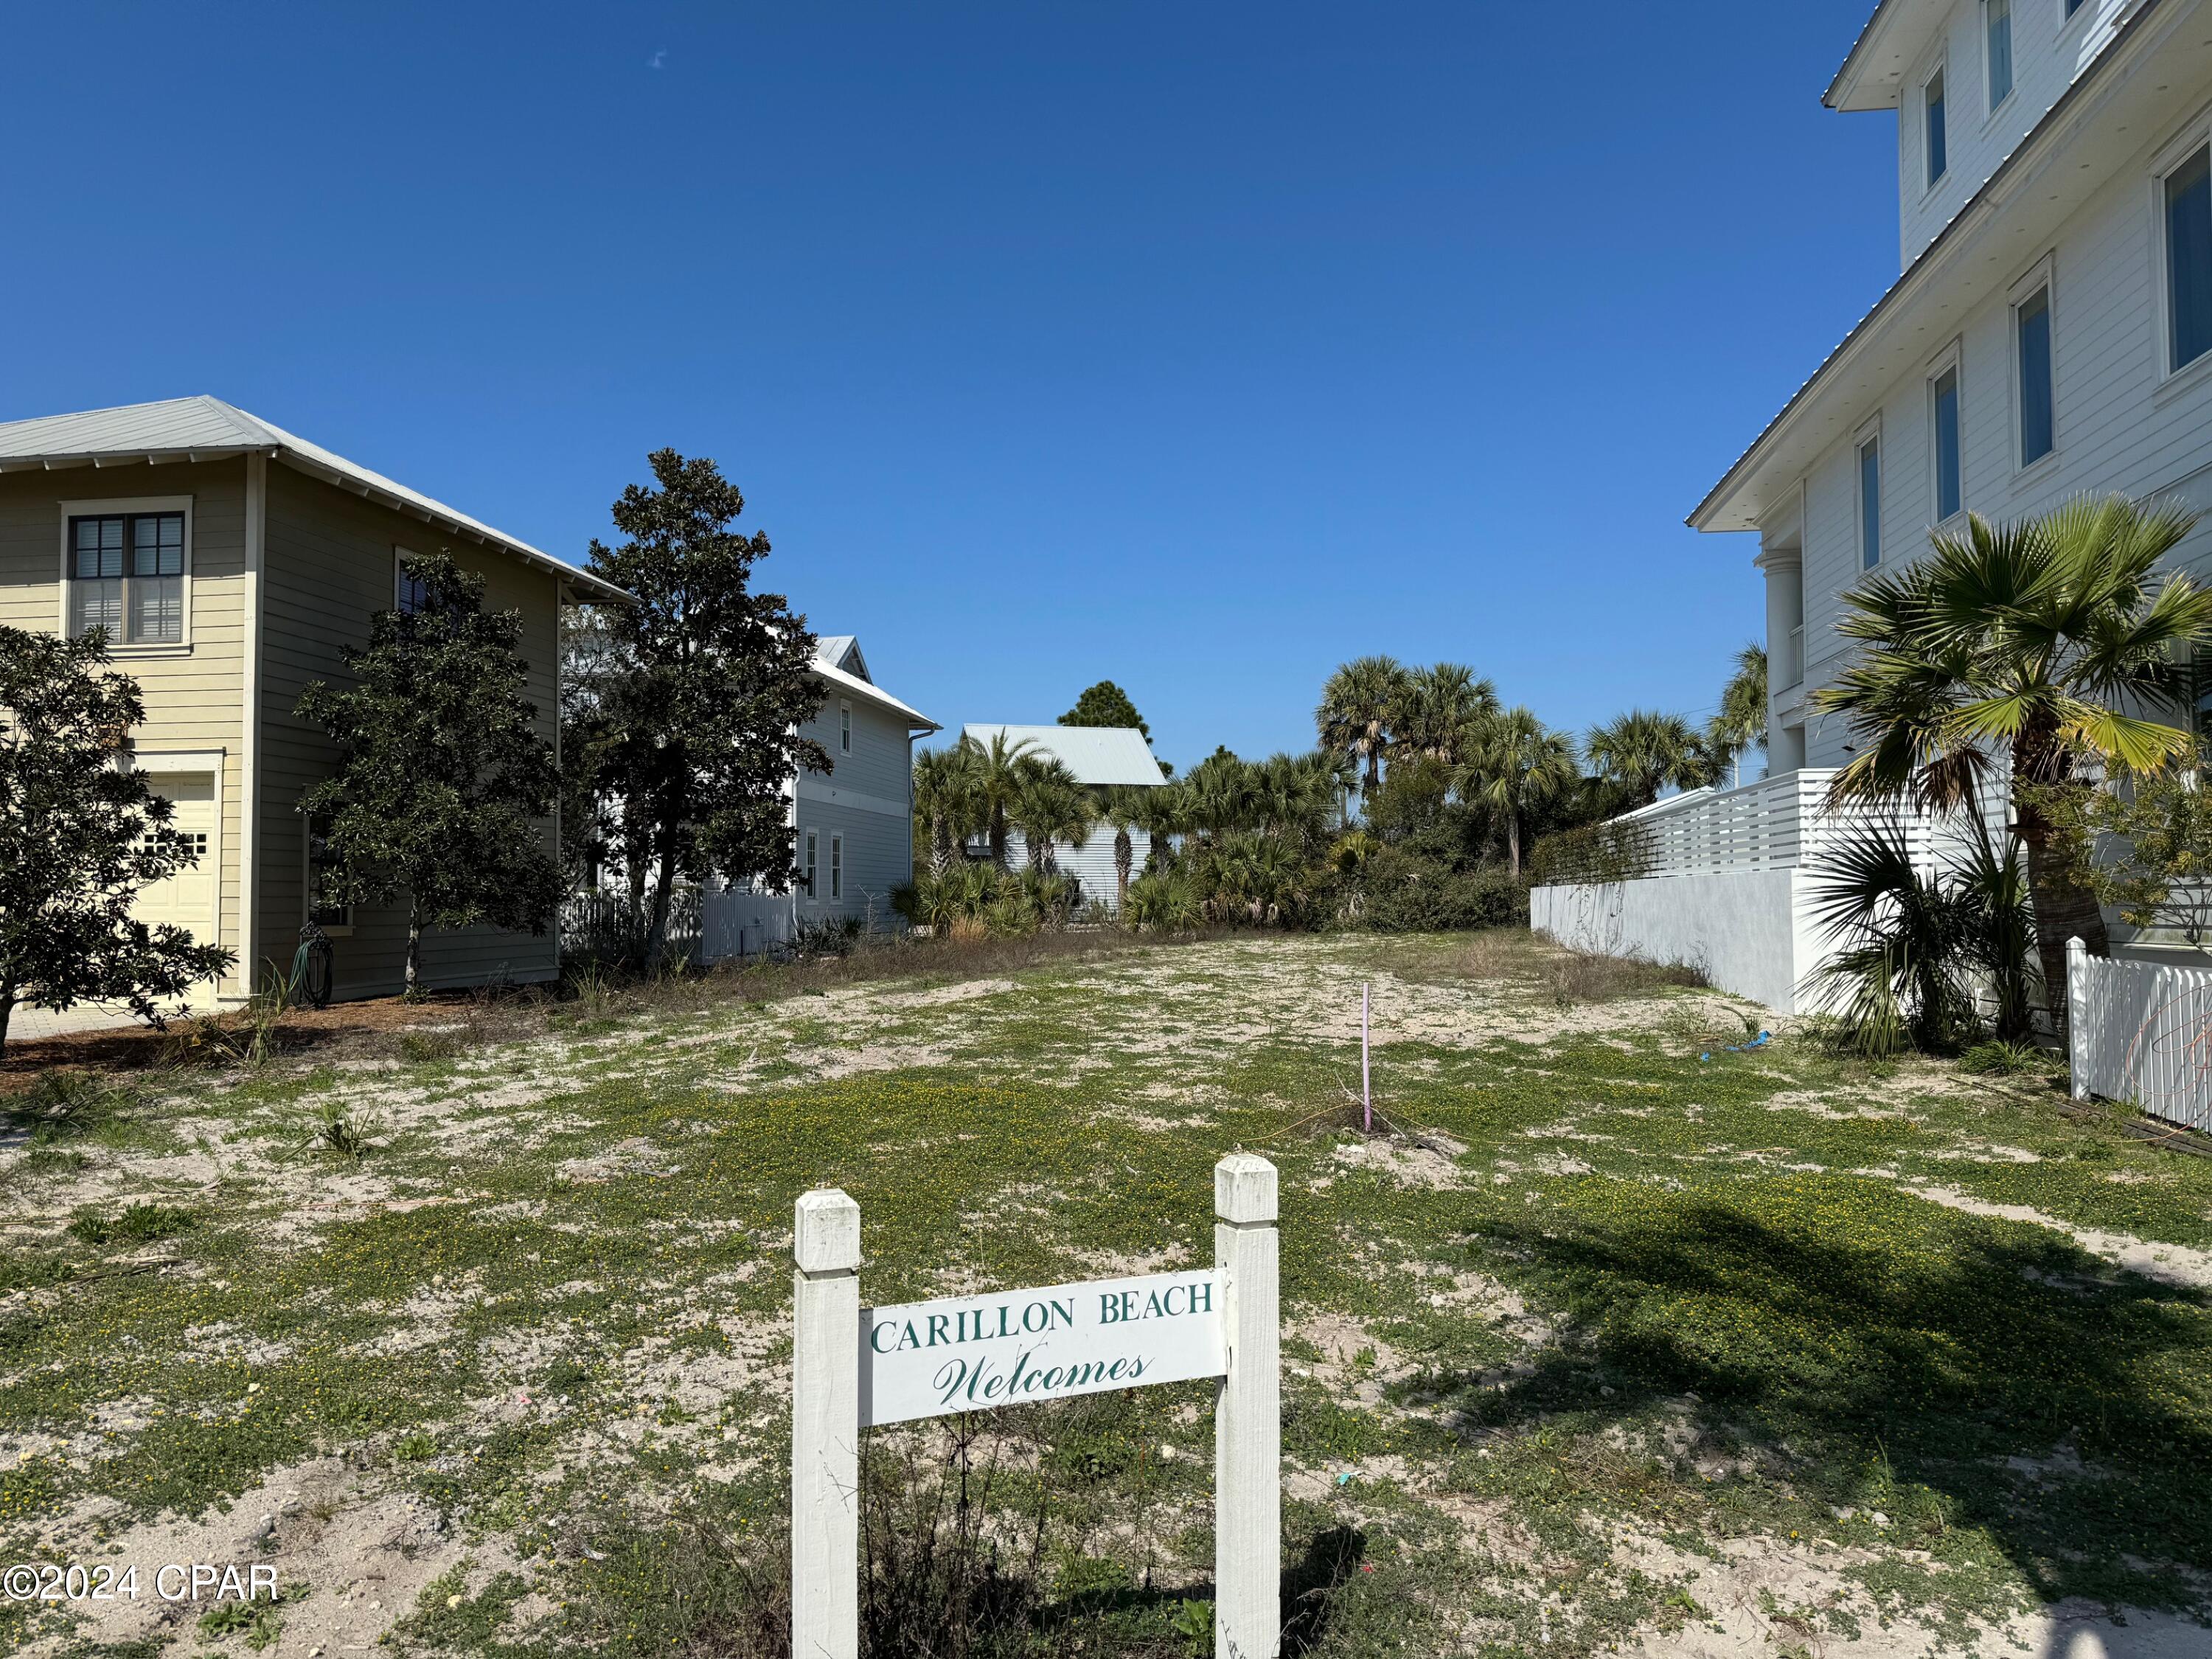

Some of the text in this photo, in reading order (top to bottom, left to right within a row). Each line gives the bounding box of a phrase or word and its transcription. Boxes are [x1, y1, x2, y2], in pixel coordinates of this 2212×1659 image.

[871, 1282, 1214, 1354] CARILLON BEACH
[933, 1351, 1155, 1405] Welcomes
